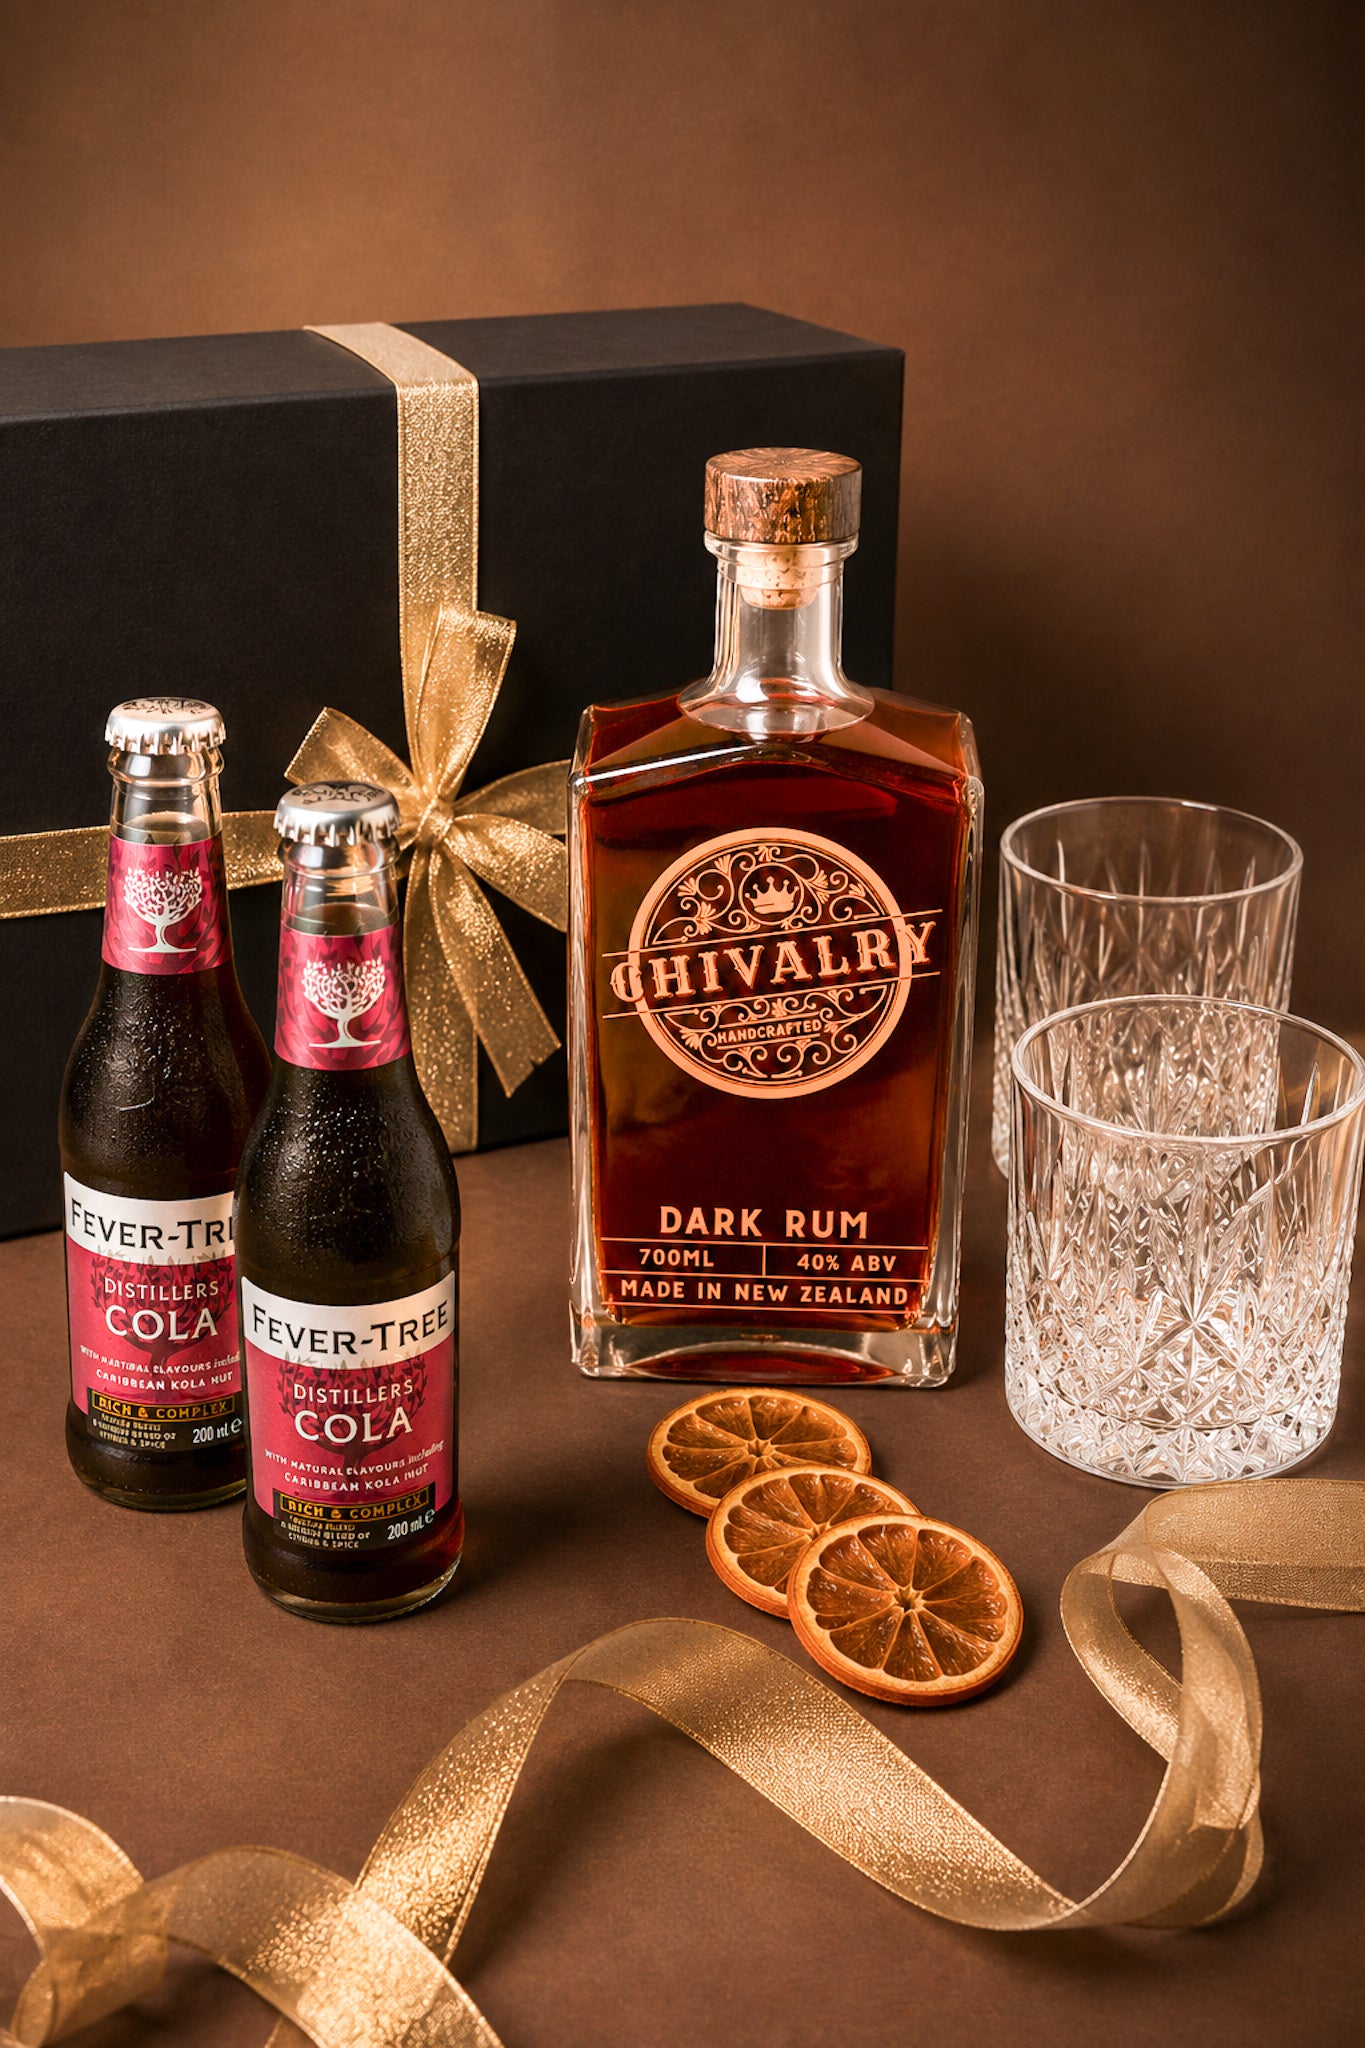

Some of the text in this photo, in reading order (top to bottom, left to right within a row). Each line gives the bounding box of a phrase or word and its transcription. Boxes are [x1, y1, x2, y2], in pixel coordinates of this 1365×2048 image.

[609, 921, 937, 1002] CHIVALRY
[716, 1019, 823, 1044] HANDCRAFTED
[71, 1198, 233, 1249] FEVER-TR
[660, 1205, 868, 1240] DARK RUM
[639, 1248, 714, 1267] 700ML
[796, 1253, 897, 1272] 40% ABV
[104, 1277, 219, 1301] DISTILLERS
[621, 1279, 908, 1305] MADE IN NEW ZEALAND
[105, 1304, 218, 1341] COLA
[252, 1300, 448, 1355] FEVER-TREE
[96, 1368, 233, 1390] CARIBBEAN KOLA NUT
[293, 1379, 413, 1405] DISTILLERS
[99, 1396, 132, 1416] RICH
[156, 1401, 228, 1419] COMPLEX
[192, 1425, 214, 1444] 200
[294, 1405, 413, 1443] COLA
[265, 1449, 287, 1465] WITH
[284, 1472, 359, 1492] CARIBBEAN
[365, 1476, 400, 1490] KOLA
[288, 1500, 323, 1517] RICH
[349, 1494, 421, 1519] COMPLEX
[387, 1521, 408, 1540] 200
